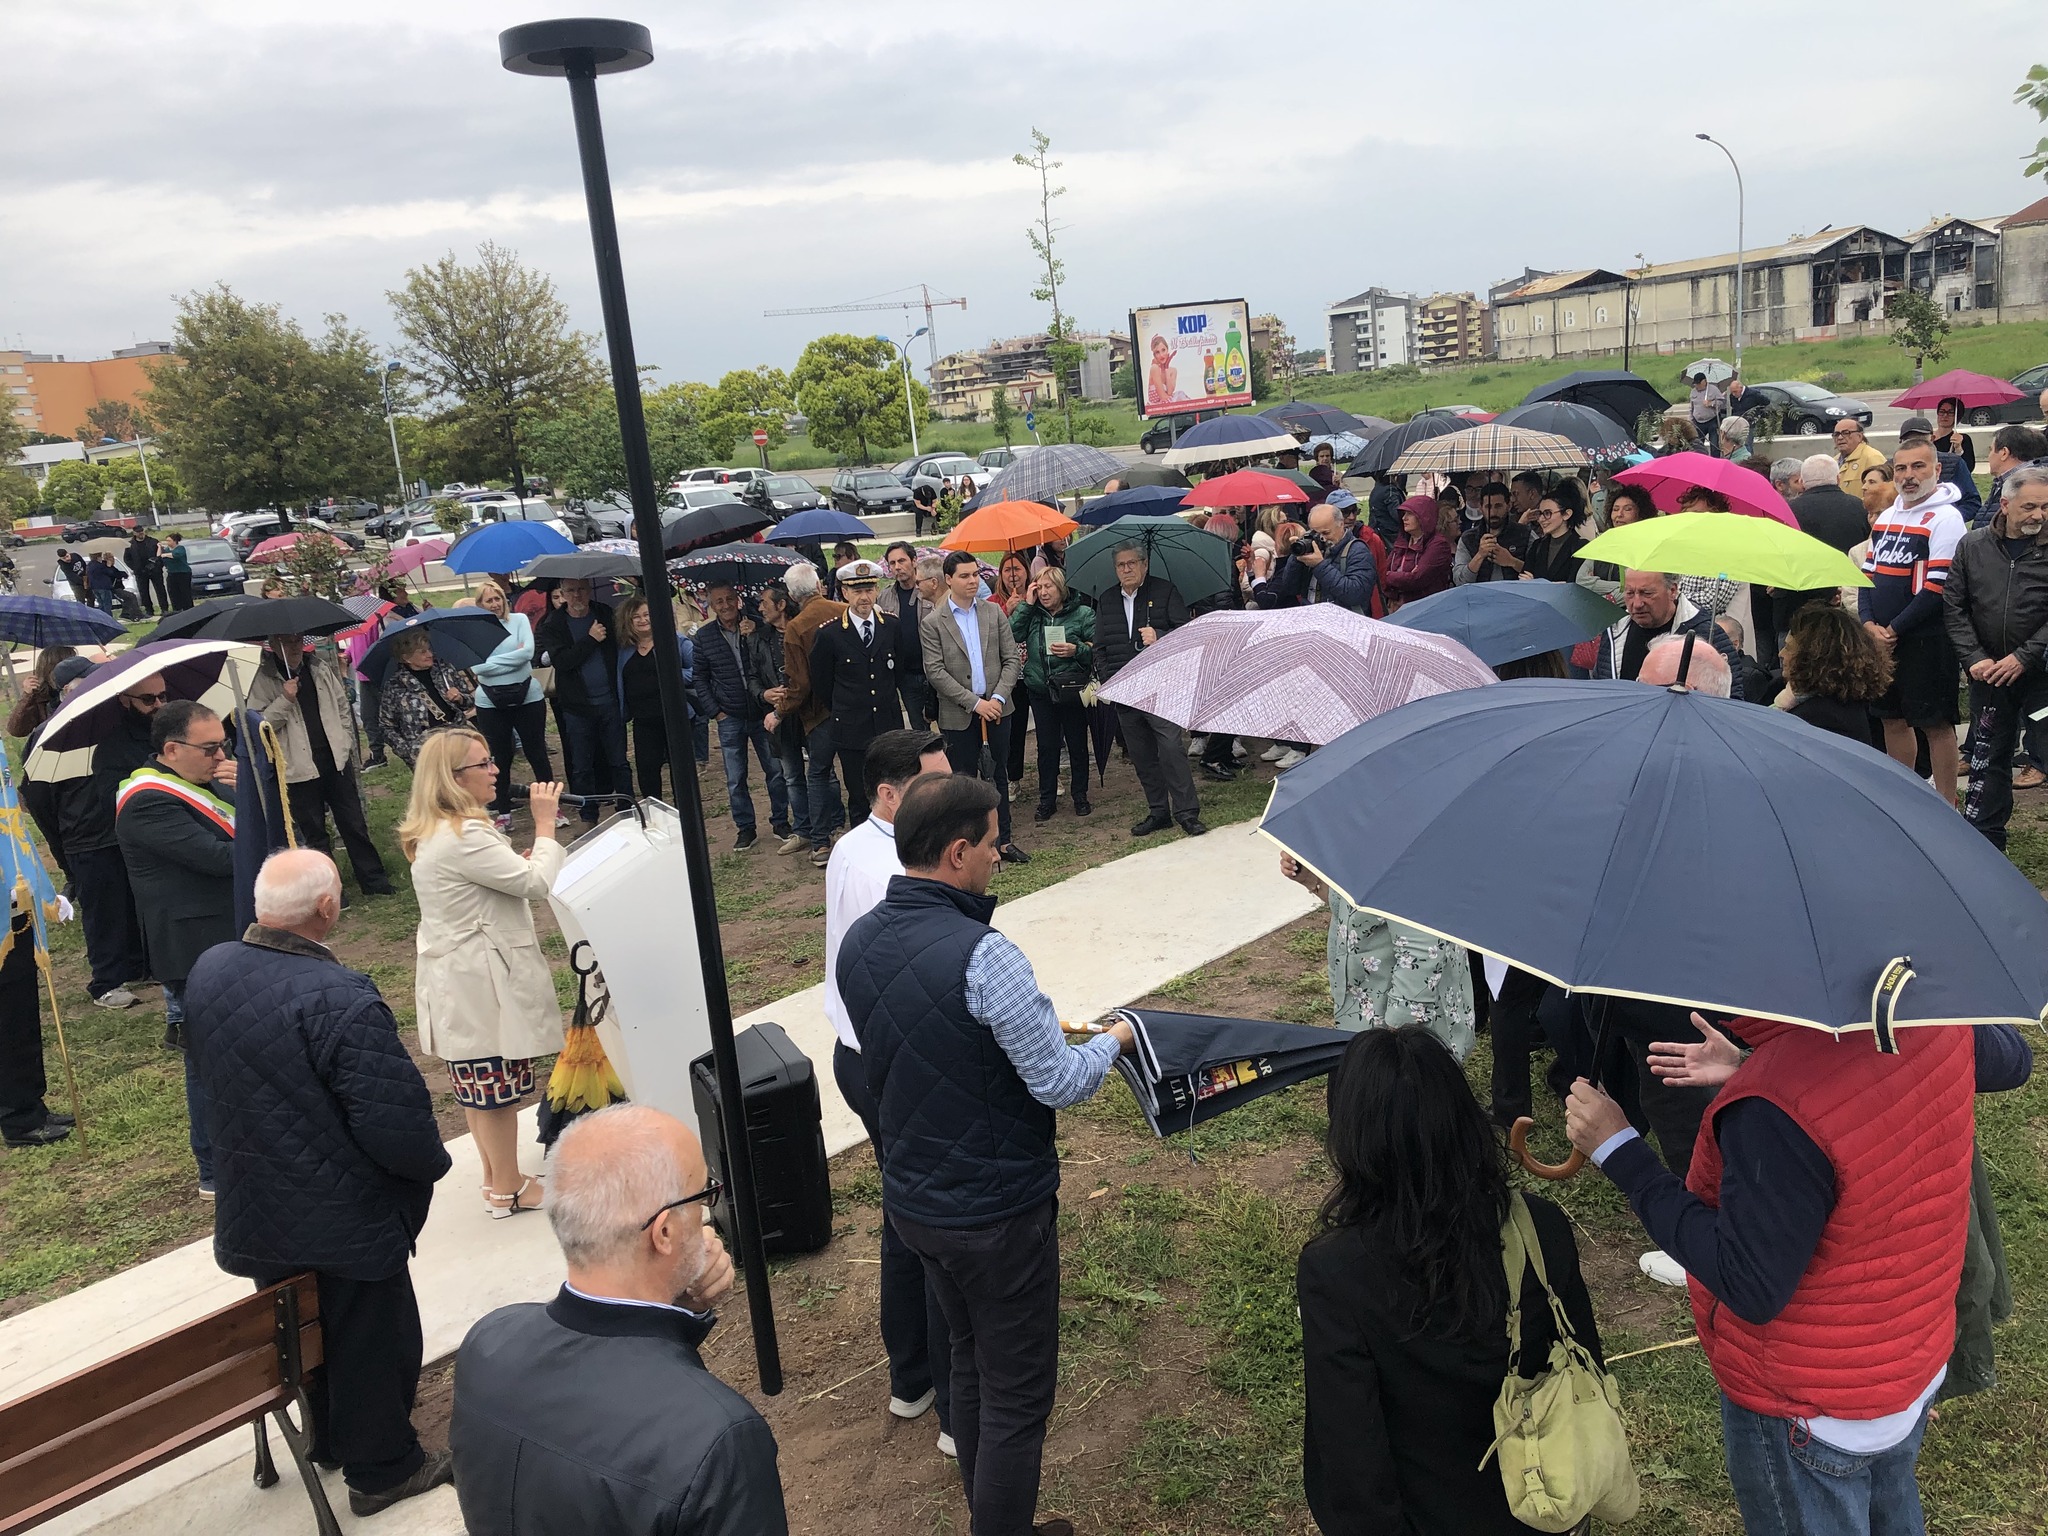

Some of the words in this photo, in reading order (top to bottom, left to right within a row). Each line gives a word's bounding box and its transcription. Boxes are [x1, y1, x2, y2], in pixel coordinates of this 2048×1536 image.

[1178, 314, 1207, 334] KOP
[1873, 539, 1919, 564] Kncks
[1257, 1057, 1273, 1077] AR
[1169, 1078, 1187, 1110] LITA
